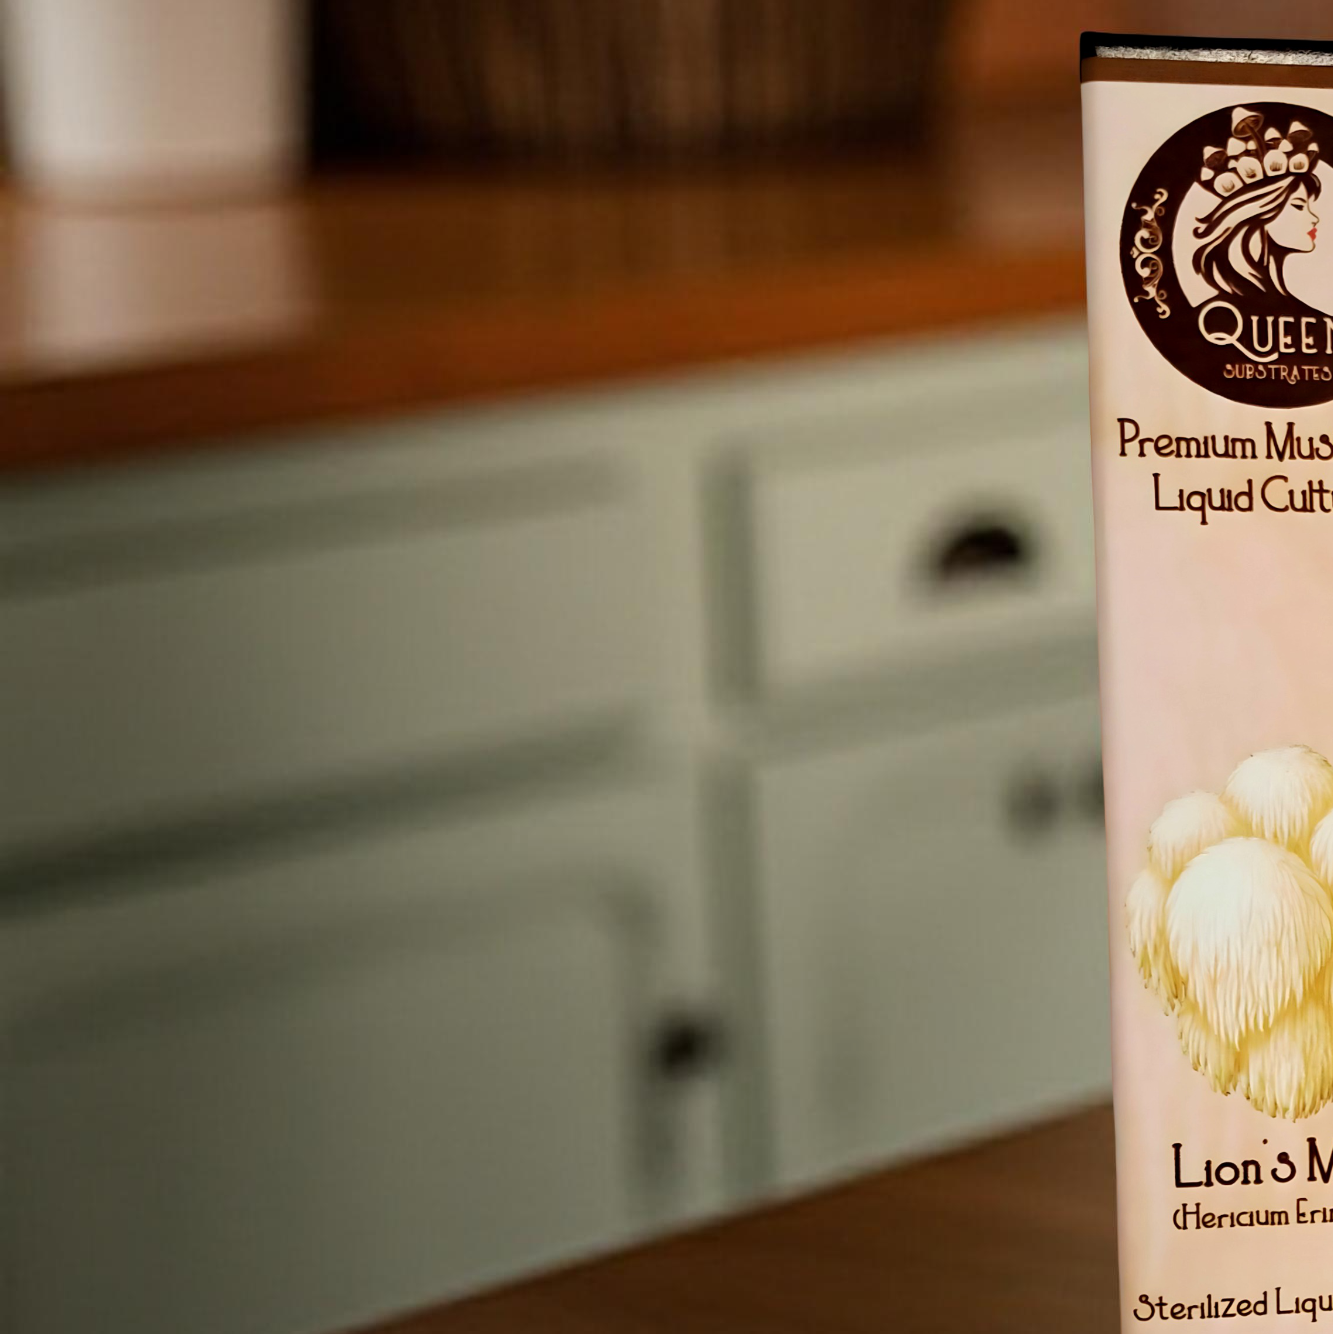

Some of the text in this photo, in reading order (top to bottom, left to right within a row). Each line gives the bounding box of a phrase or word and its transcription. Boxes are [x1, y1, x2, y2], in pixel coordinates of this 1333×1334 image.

[1223, 364, 1333, 384] SUBSTRATES
[1116, 417, 1259, 460] Premium
[1151, 472, 1254, 526] Liquid
[1171, 1138, 1297, 1189] Lion's
[1172, 1201, 1291, 1231] (Hericium
[1132, 1290, 1268, 1322] Sterilized
